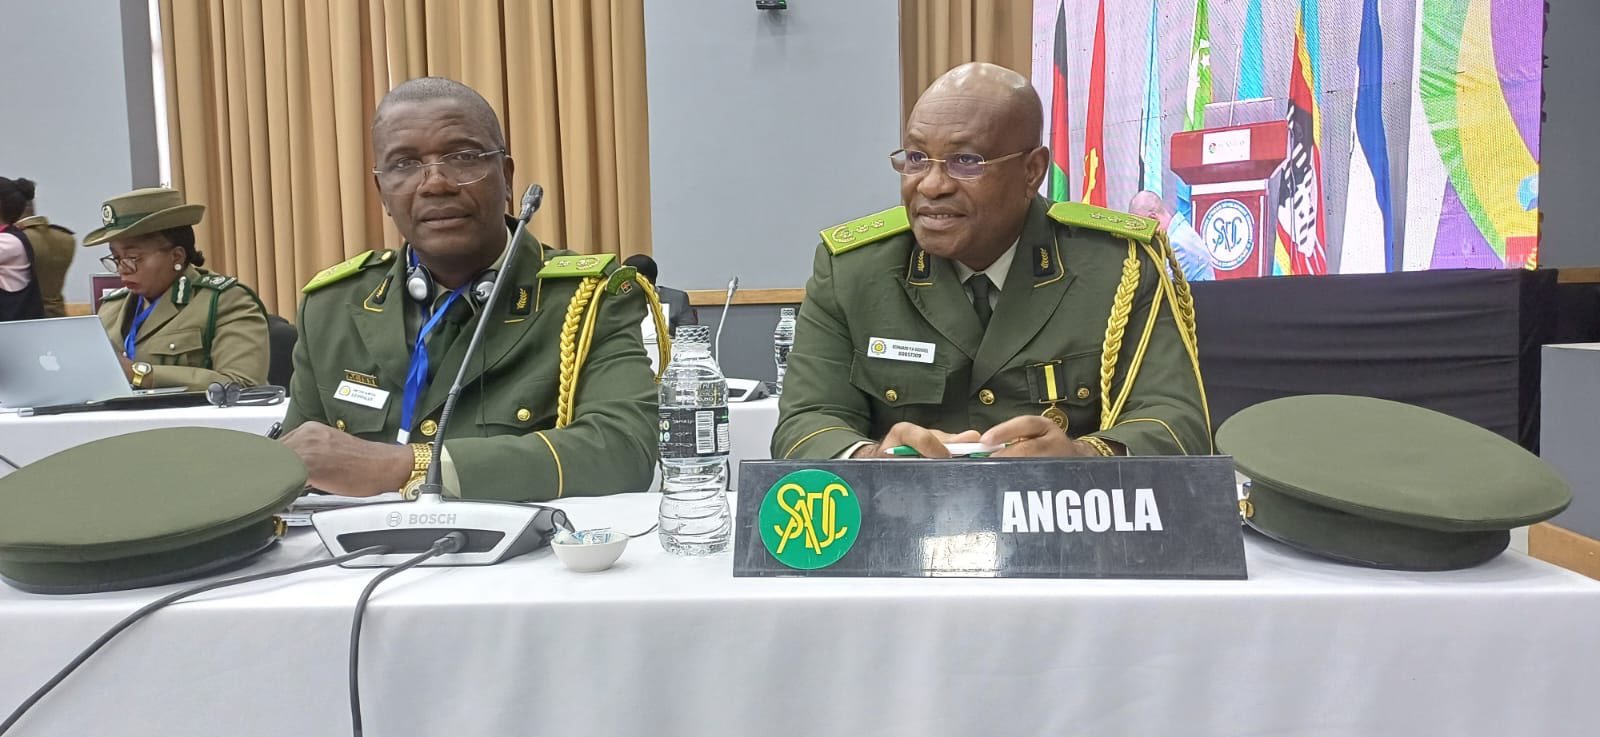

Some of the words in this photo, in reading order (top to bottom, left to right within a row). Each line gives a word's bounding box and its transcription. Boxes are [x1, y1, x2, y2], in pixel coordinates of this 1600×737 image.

[408, 513, 457, 525] BOSCH
[773, 483, 849, 554] SADC
[1001, 488, 1164, 533] ANGOLA
